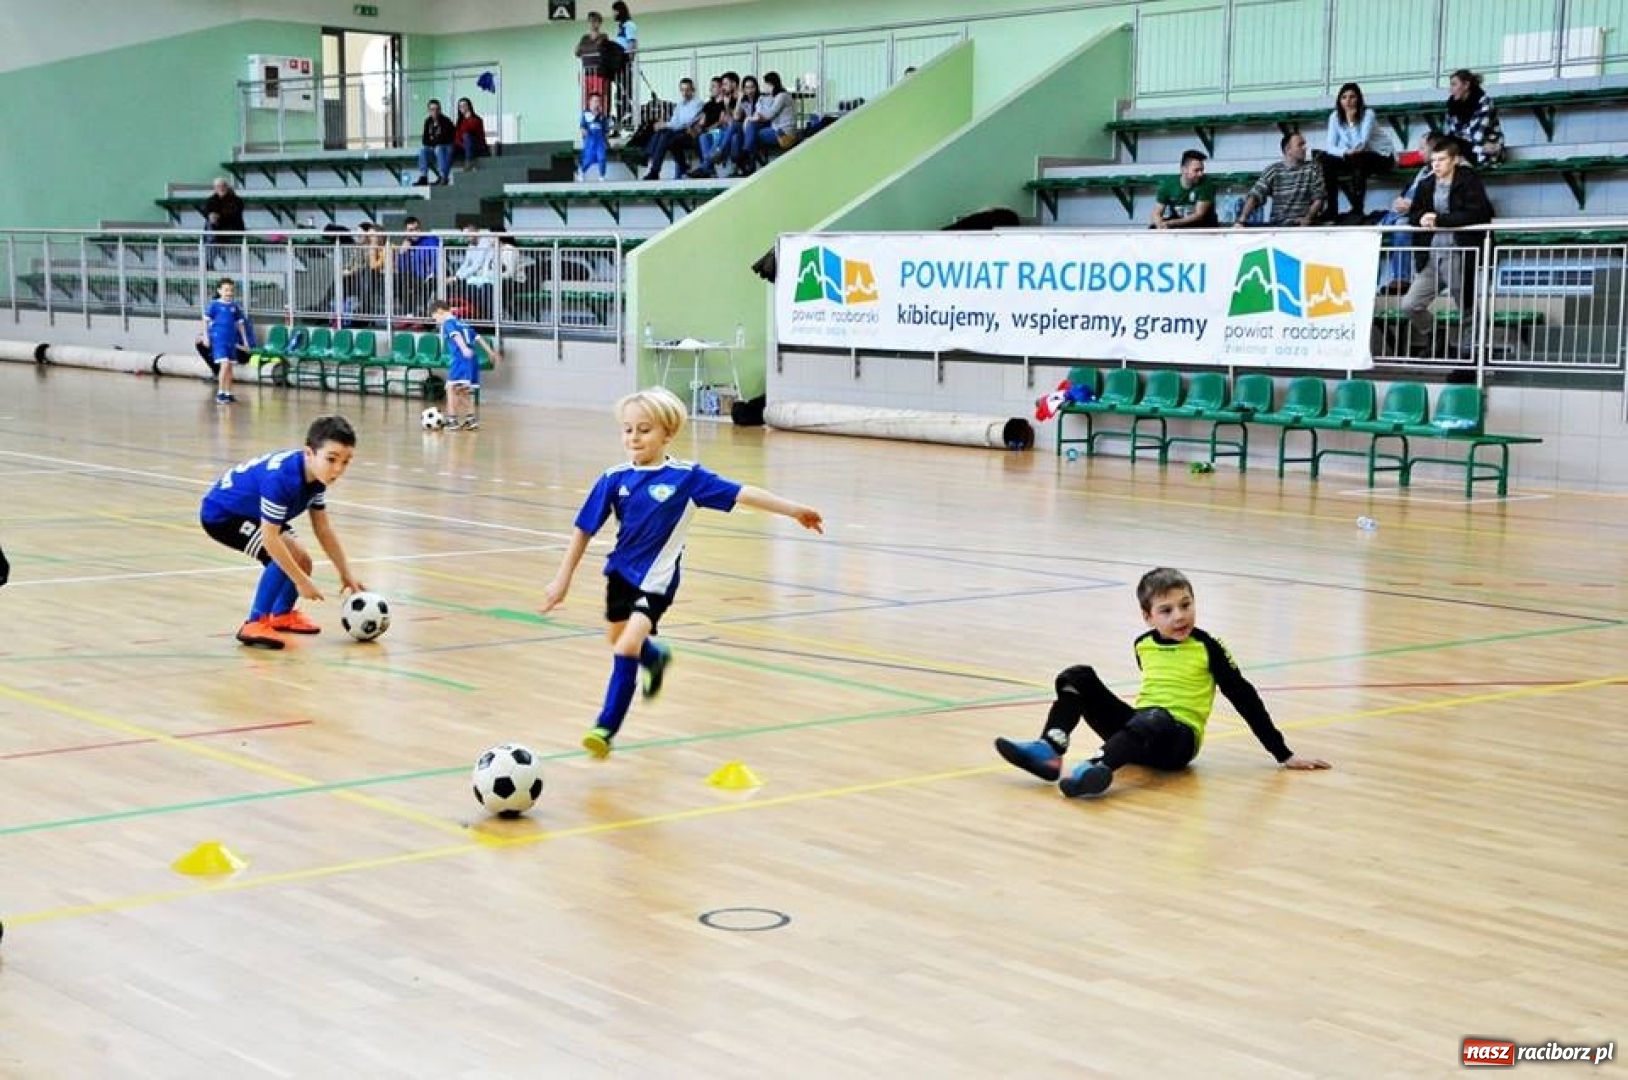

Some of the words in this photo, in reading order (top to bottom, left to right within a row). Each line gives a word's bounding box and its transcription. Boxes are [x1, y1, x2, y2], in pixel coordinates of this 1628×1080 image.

[552, 6, 571, 18] A
[900, 260, 1010, 289] POWIAT
[1018, 261, 1207, 293] RACIBORSKI
[897, 303, 1000, 333] kibicujemy,
[1012, 308, 1127, 338] wspieramy,
[1134, 314, 1208, 341] gramy
[1223, 324, 1274, 342] powiat
[1282, 323, 1356, 341] raciborski
